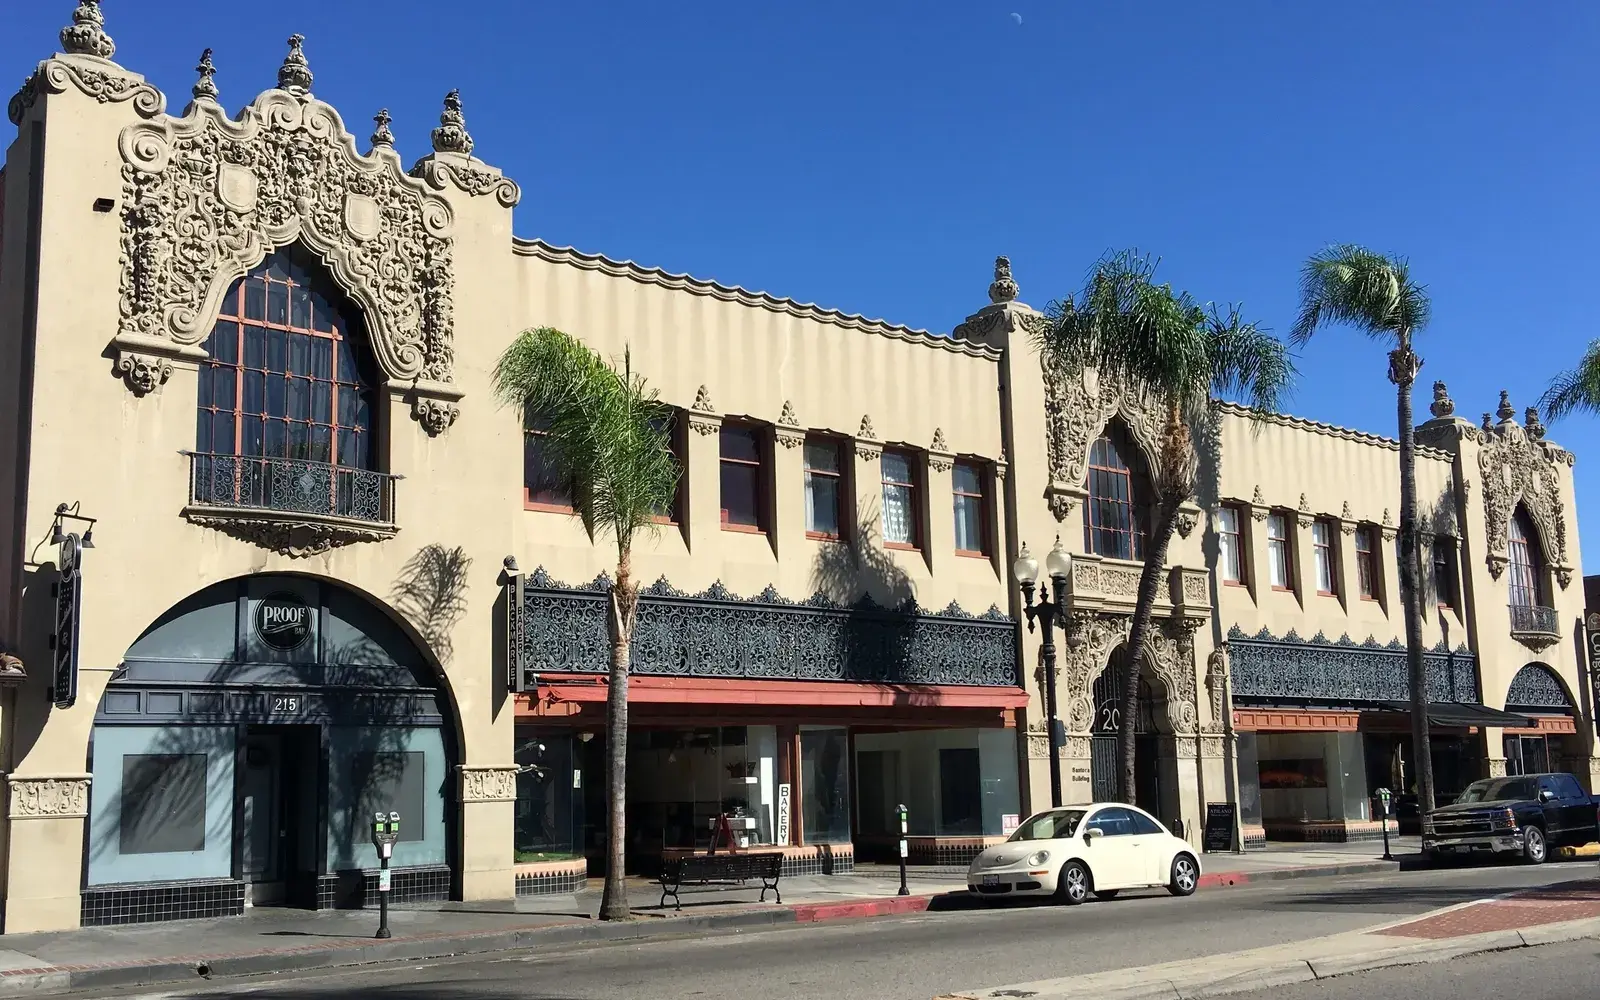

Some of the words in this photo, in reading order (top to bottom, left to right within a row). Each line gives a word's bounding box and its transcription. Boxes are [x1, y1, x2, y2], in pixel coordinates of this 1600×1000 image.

[263, 606, 306, 630] PROOF
[274, 697, 296, 711] 215
[1102, 708, 1120, 731] 20
[780, 786, 789, 843] BAKERY
